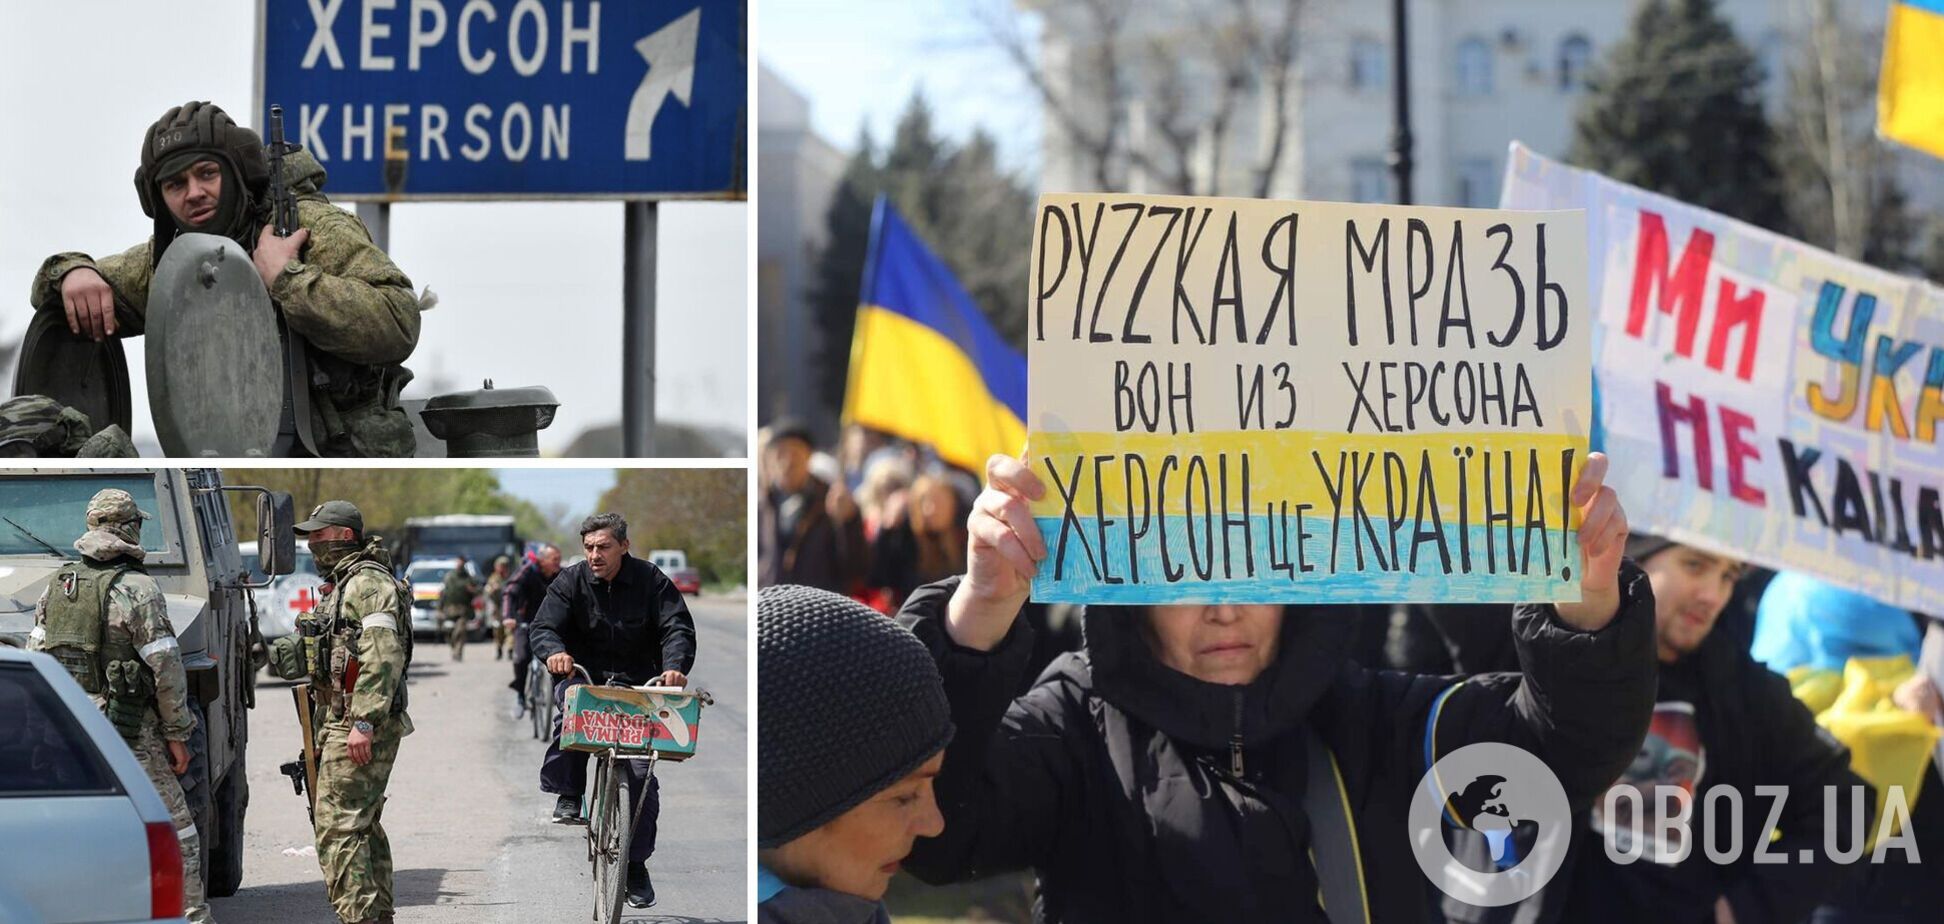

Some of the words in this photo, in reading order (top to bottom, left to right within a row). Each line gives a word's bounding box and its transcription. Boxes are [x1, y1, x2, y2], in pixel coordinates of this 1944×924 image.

[301, 0, 600, 76] ХЕРСОН
[300, 102, 570, 162] KHERSON
[1346, 218, 1568, 350] МРАЗЬ
[1114, 360, 1194, 434] ВОН
[1236, 362, 1296, 430] ИЗ
[1342, 360, 1543, 434] ХЕРСОНА
[1654, 381, 1767, 507] НЕ
[1044, 453, 1255, 584] ХЕРСОН
[1311, 445, 1576, 582] УКРАЇНА!
[583, 710, 645, 727] DONNA
[584, 726, 644, 745] PRIMA
